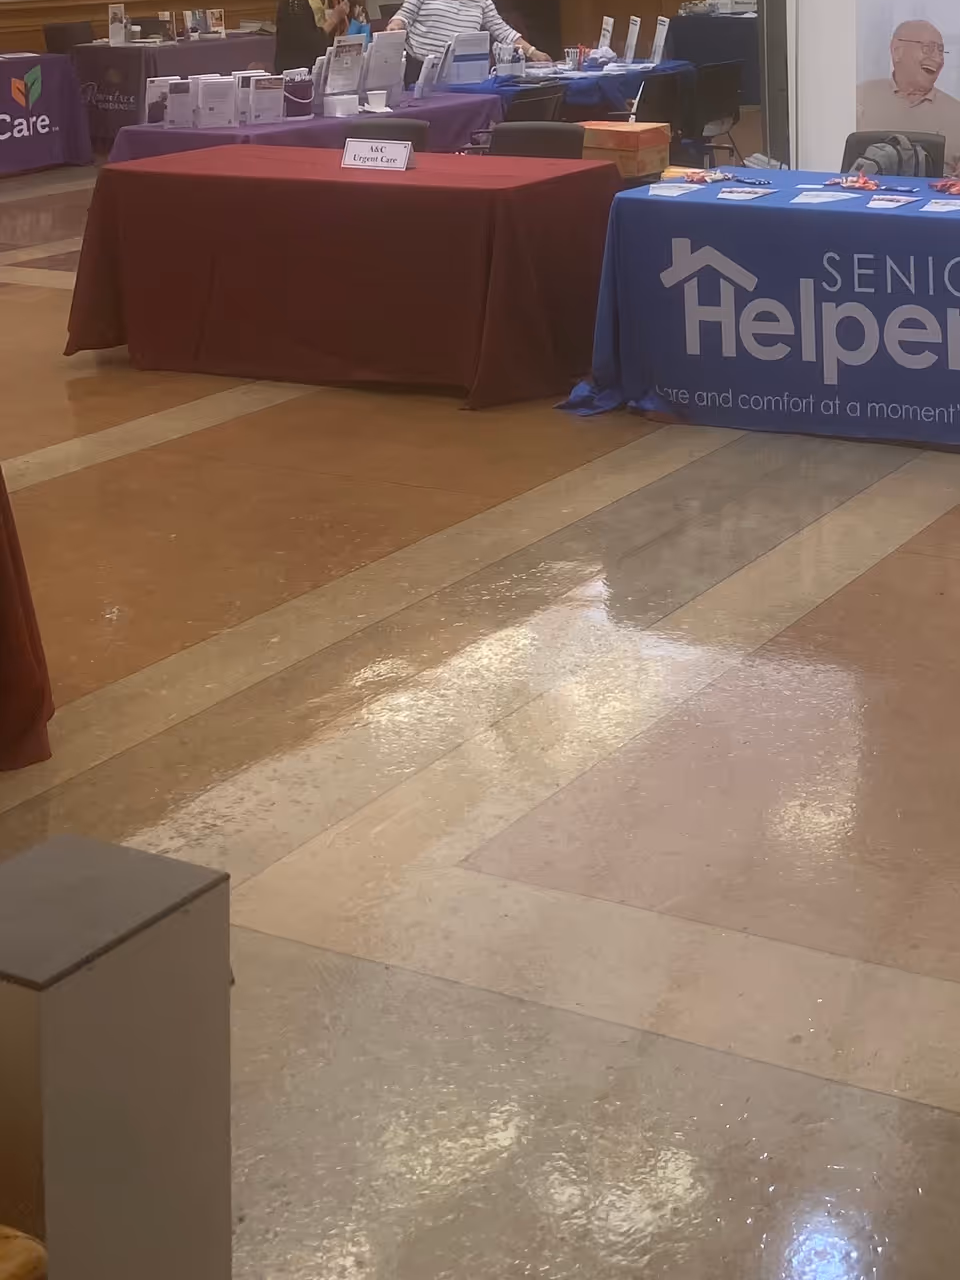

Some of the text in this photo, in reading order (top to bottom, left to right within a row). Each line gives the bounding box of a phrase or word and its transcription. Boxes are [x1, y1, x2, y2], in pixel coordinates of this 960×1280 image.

[369, 145, 387, 153] A&C
[353, 154, 398, 164] Urgent Care
[694, 388, 733, 408] and
[738, 391, 815, 414] comfort
[820, 396, 841, 416] at
[846, 400, 861, 417] a
